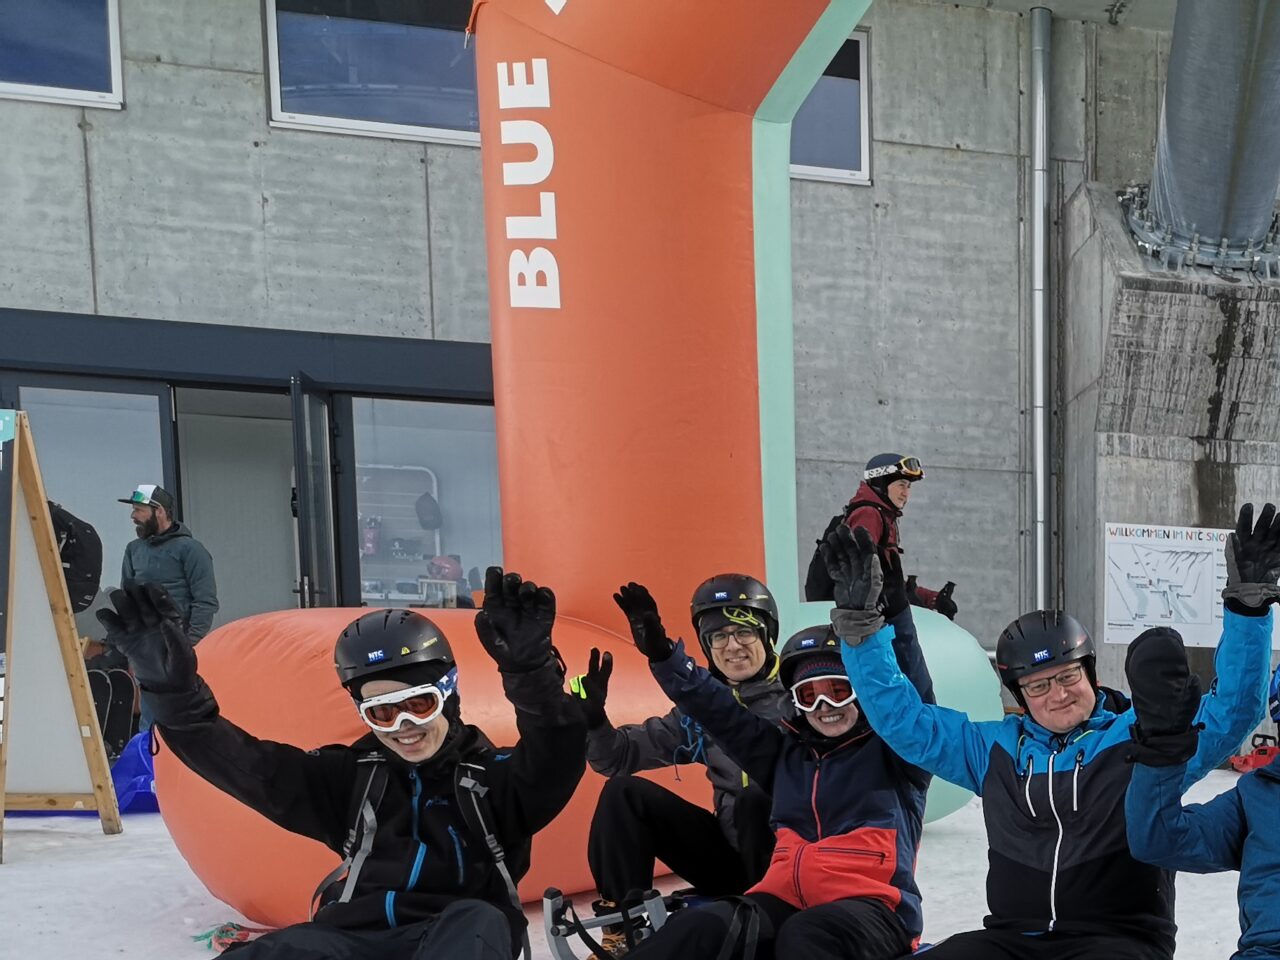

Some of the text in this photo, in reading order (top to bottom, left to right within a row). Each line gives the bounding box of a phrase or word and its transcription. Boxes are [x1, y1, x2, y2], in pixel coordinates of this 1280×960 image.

[497, 58, 561, 309] BLUE
[1108, 526, 1171, 540] WILLKOMMEN
[1172, 529, 1184, 540] IM
[1185, 530, 1203, 541] NTC
[368, 649, 384, 660] NTC
[1034, 649, 1048, 659] NTC
